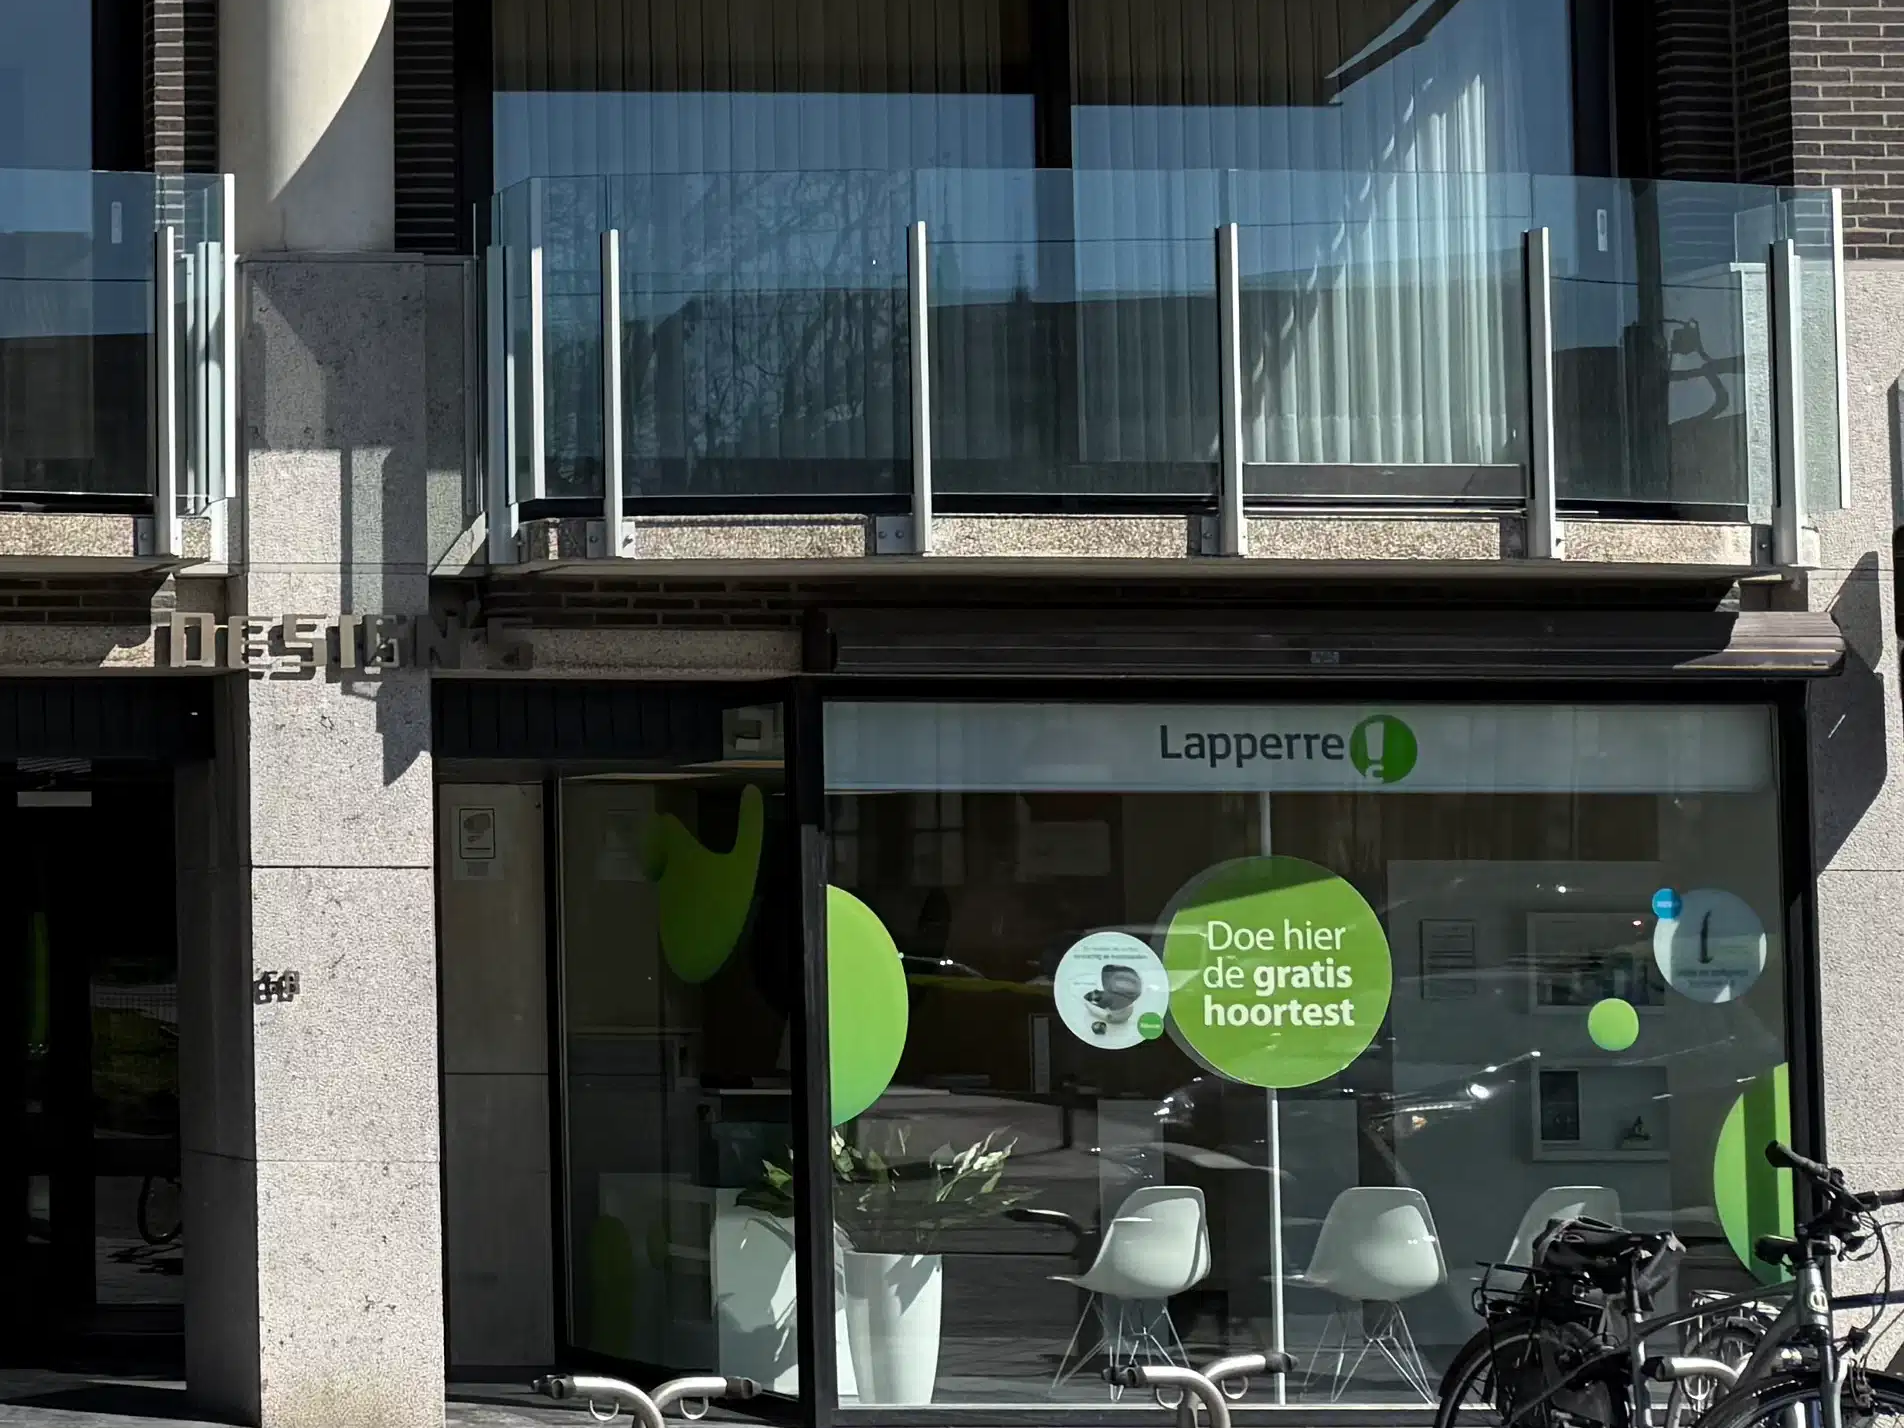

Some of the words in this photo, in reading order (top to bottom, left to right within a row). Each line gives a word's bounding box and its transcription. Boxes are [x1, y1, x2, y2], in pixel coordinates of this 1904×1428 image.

[1160, 725, 1345, 768] Lapperre
[1207, 920, 1274, 951] Doe
[1284, 919, 1347, 951] hier
[1203, 957, 1245, 989] de
[1253, 958, 1353, 998] gratis
[1204, 995, 1356, 1027] hoortest
